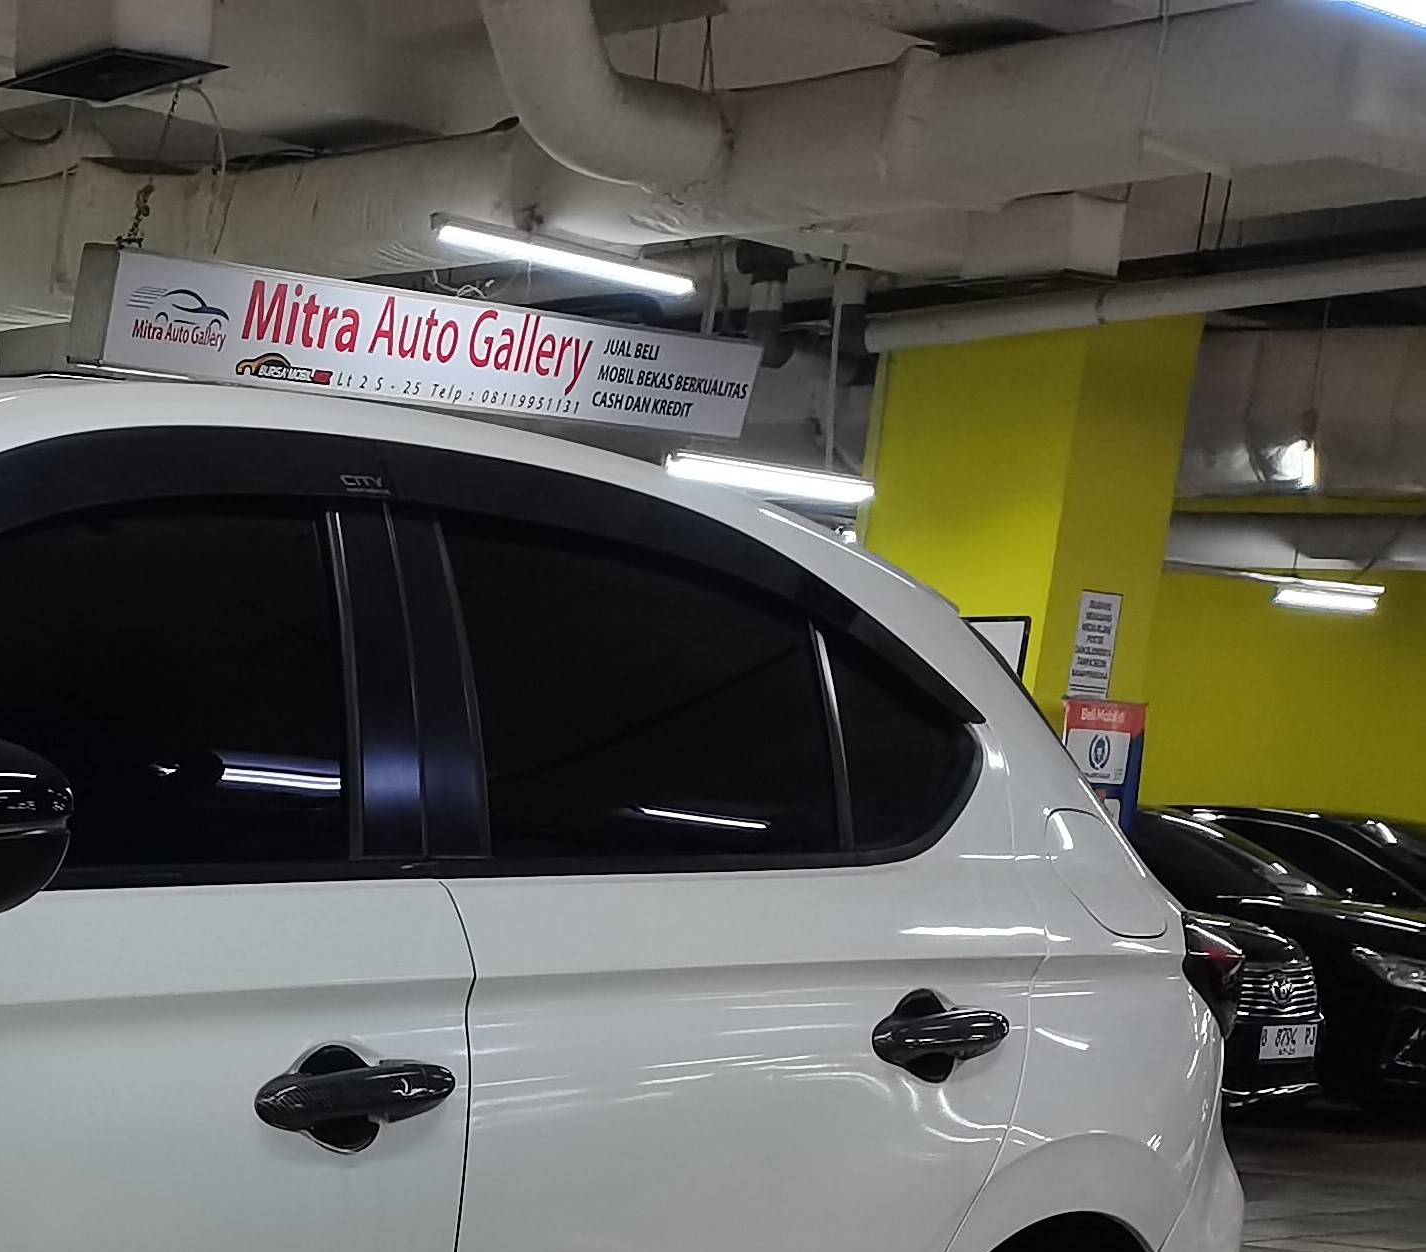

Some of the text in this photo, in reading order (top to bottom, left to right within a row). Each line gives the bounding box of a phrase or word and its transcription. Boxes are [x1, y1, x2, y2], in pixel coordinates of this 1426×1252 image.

[132, 318, 227, 351] Mitra Auto Gallery
[240, 279, 594, 396] Mitra Auto Gallery
[603, 338, 660, 361] JUAL BELI
[359, 374, 369, 390] 2
[402, 380, 422, 396] 25
[431, 382, 462, 404] Telp
[597, 364, 749, 400] MOBIL BEKAS BERKUALITAS
[591, 391, 694, 418] CASH DAN KREDIT
[339, 474, 382, 487] CITY
